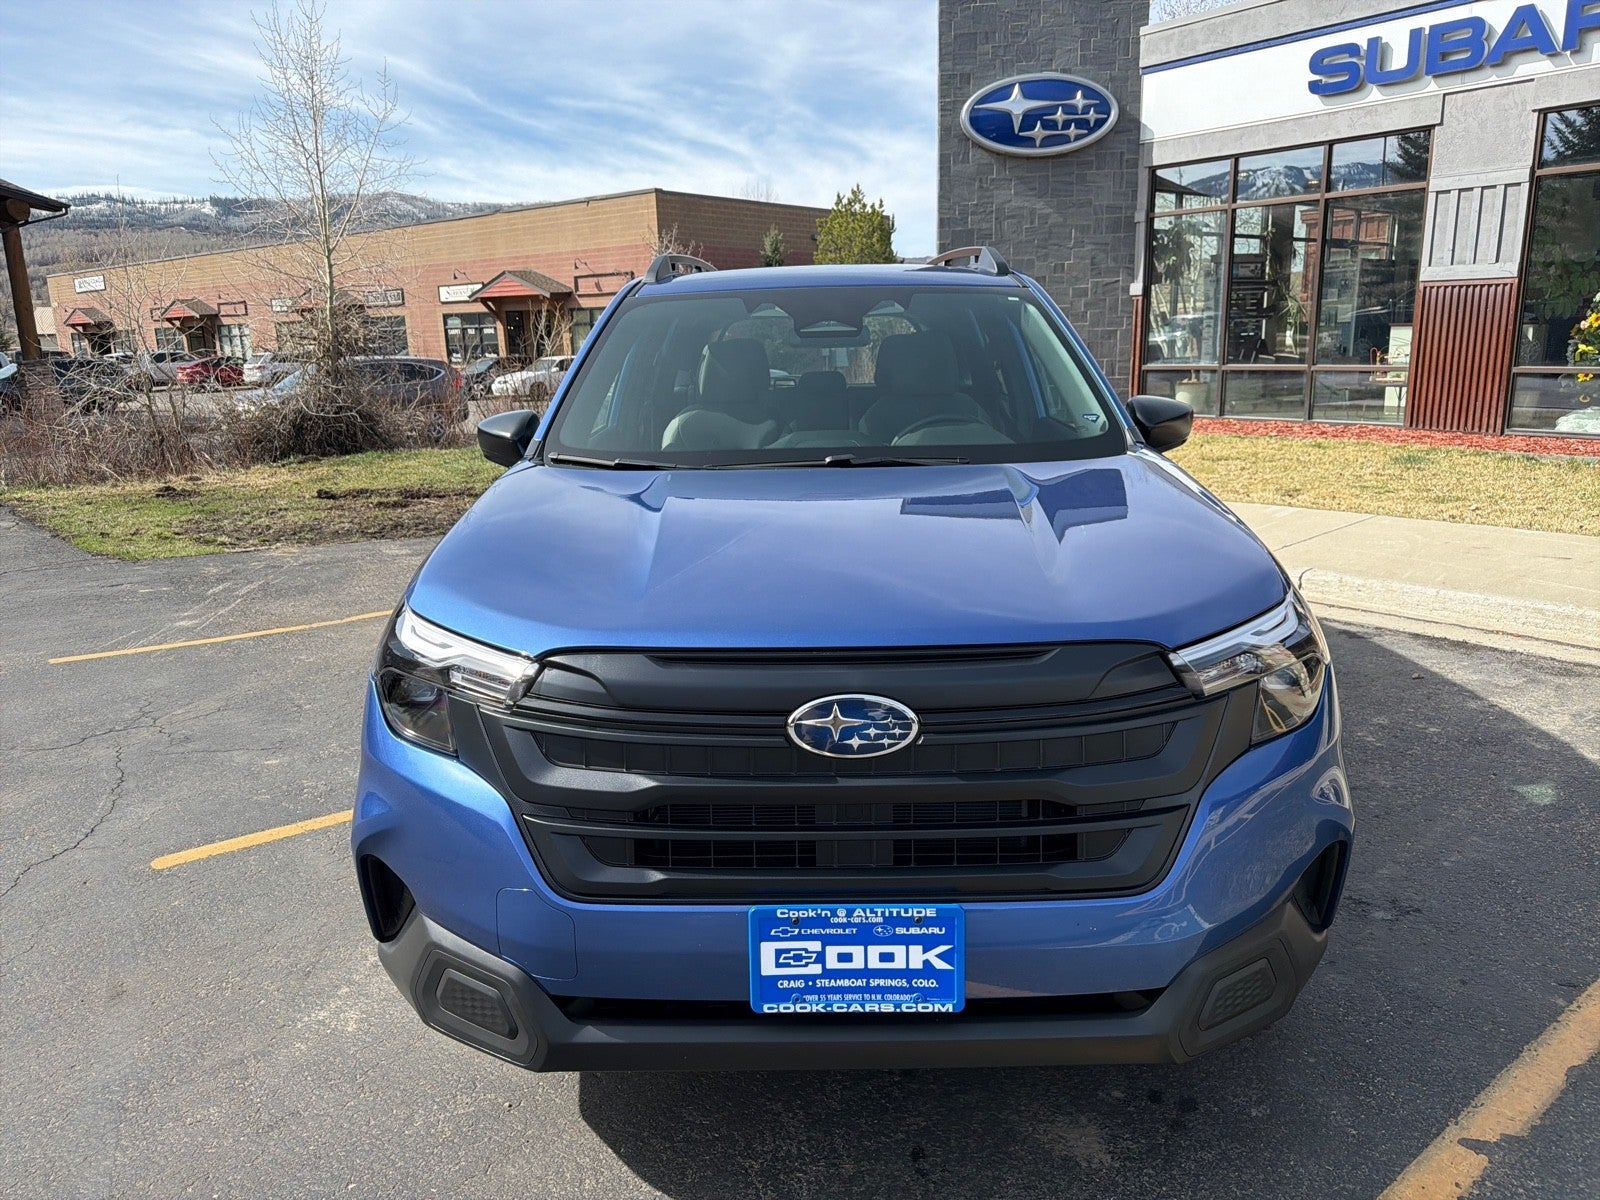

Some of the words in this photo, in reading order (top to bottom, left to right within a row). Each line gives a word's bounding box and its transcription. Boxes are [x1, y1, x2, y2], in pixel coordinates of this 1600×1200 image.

[776, 908, 831, 918] Cook'n
[836, 908, 847, 917] @
[852, 907, 937, 917] ALTITUDE
[830, 916, 883, 924] cook-cars.com
[801, 927, 858, 935] CHEVROLET
[895, 926, 946, 935] SUBARU
[777, 979, 806, 988] CRAIG
[815, 978, 867, 988] STEAMBOAT
[869, 978, 910, 988] SPRINGS,
[911, 978, 939, 988] COLO.
[843, 993, 863, 1001] SERVICE
[863, 993, 871, 1001] TO
[762, 1003, 953, 1013] COOK-CARS.COM
